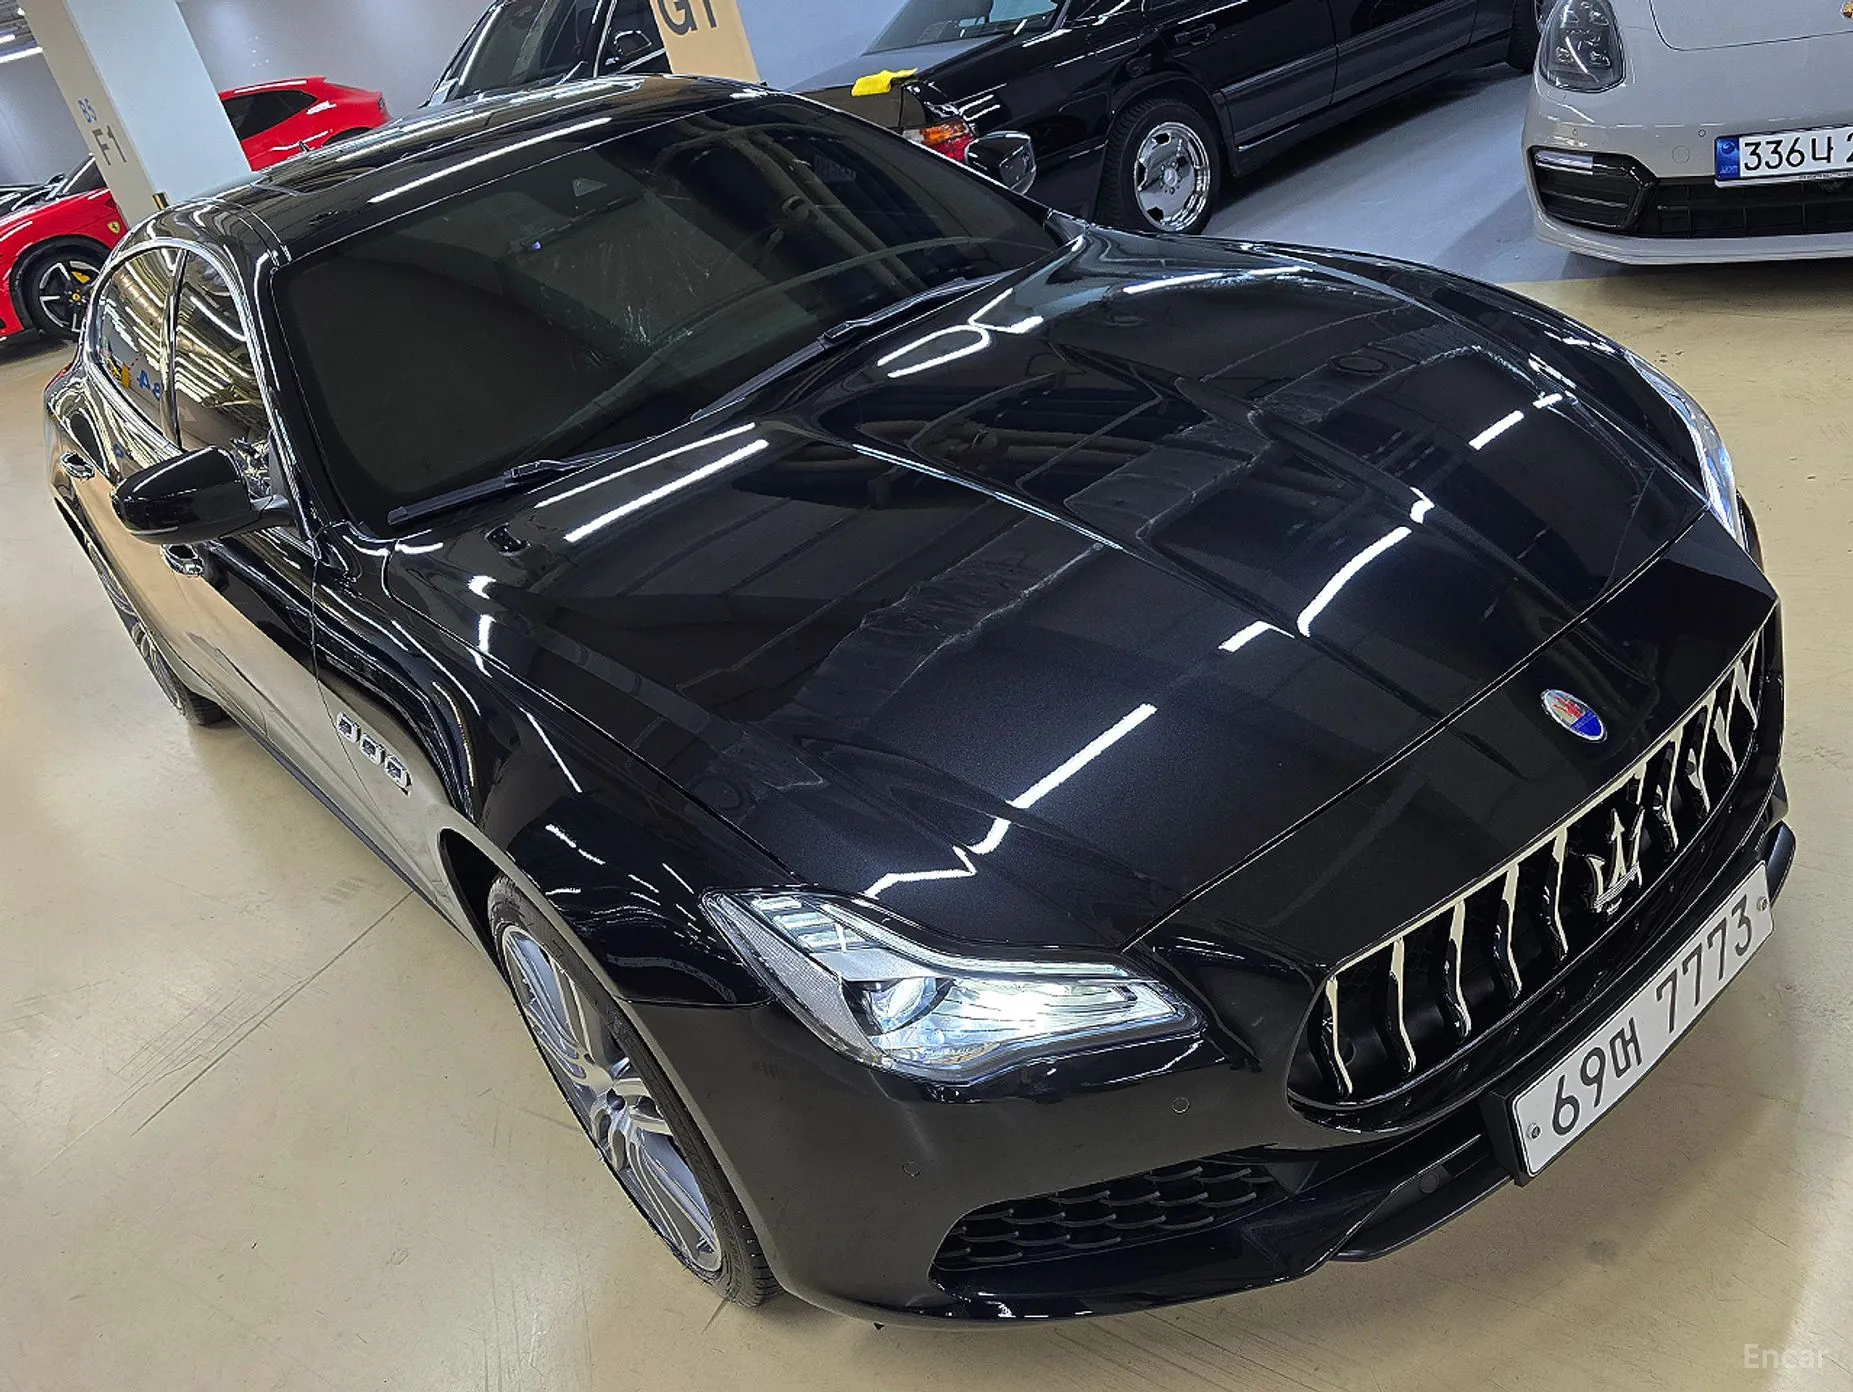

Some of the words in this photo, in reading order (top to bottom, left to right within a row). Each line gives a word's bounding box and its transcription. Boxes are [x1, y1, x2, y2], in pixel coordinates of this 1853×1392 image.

[92, 125, 127, 166] F1
[1744, 136, 1834, 172] 336나
[1551, 1017, 1643, 1136] 69머
[1656, 894, 1754, 1034] 7773
